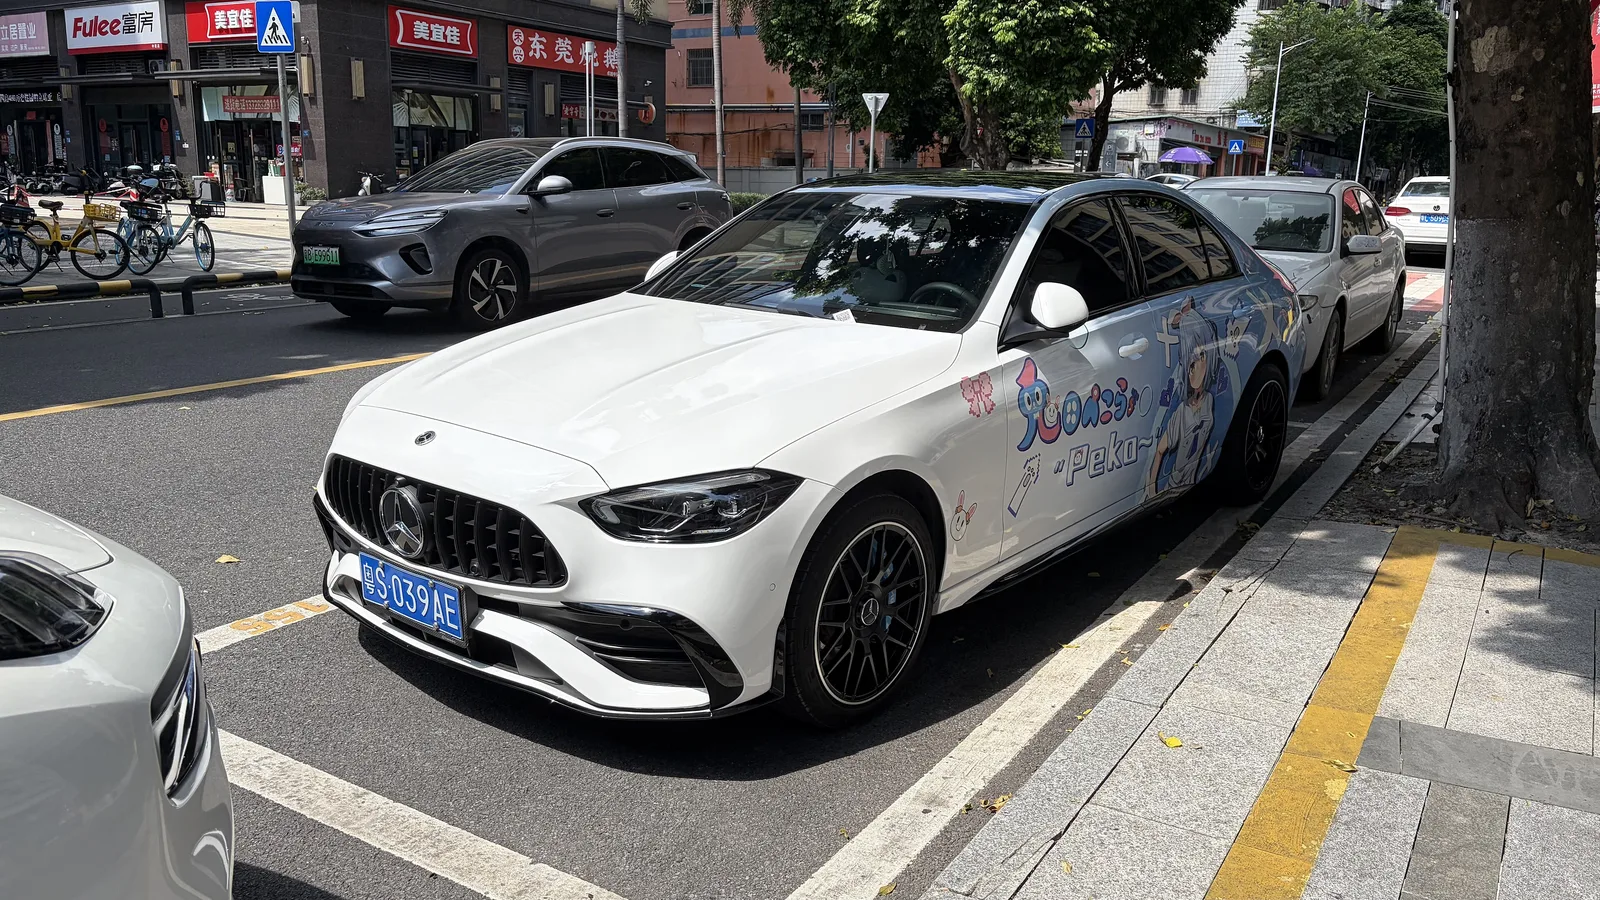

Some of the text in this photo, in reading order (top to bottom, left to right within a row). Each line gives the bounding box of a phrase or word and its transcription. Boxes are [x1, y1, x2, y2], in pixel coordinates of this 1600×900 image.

[72, 11, 153, 39] Fulee 富房
[214, 8, 254, 30] 美宜佳
[413, 20, 460, 45] 美宜佳
